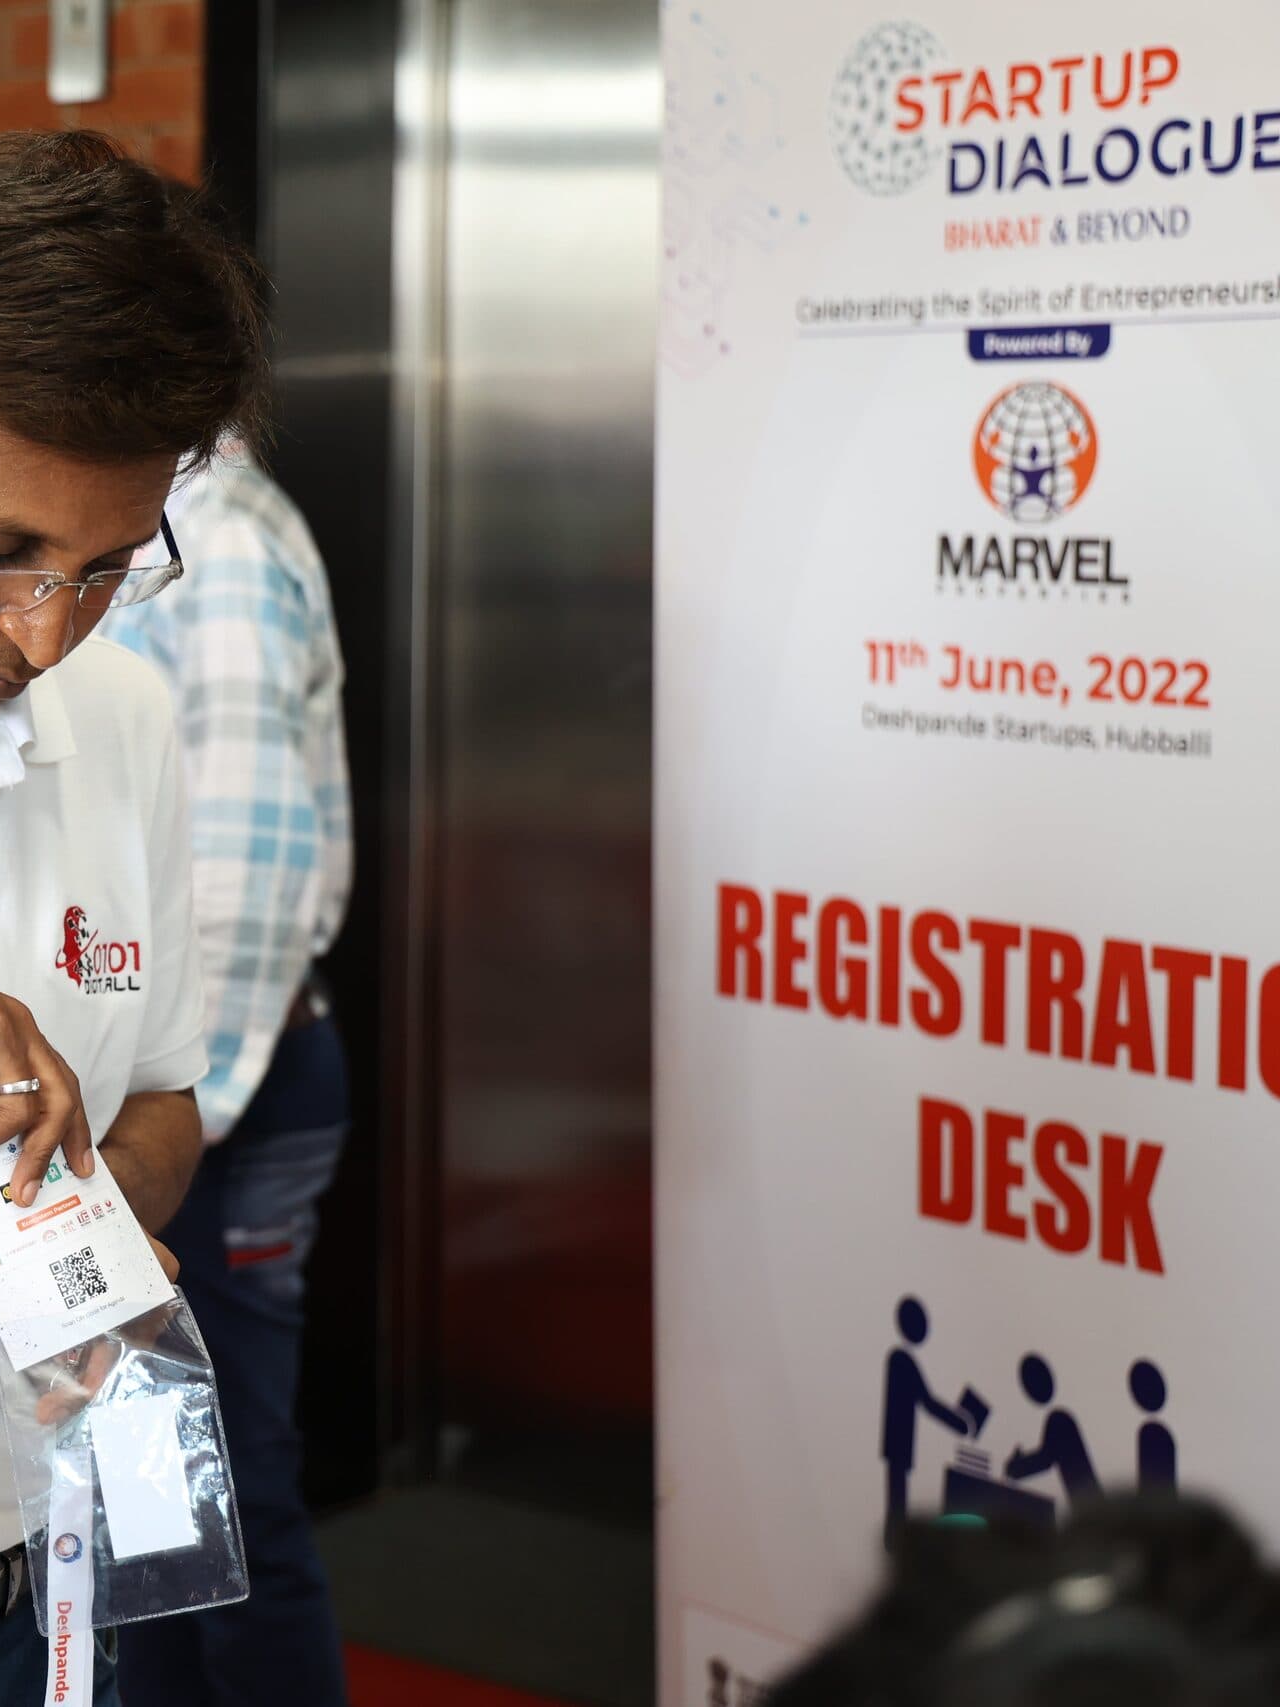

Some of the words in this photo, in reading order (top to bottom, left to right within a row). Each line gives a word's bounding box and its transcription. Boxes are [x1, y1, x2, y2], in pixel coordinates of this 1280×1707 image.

[895, 46, 1179, 132] STARTUP
[948, 111, 1280, 195] DIALOGUE
[944, 212, 1042, 251] BHARAT
[1050, 214, 1068, 246] &
[1077, 204, 1192, 244] BEYOND
[797, 294, 923, 326] Celebrating
[932, 289, 970, 315] the
[978, 284, 1041, 316] Spirit
[1048, 284, 1073, 312] of
[983, 330, 1063, 356] Powered
[1065, 329, 1092, 357] By
[939, 534, 1130, 584] MARVEL
[940, 644, 1071, 708] June,
[1086, 653, 1211, 709] 2022
[862, 702, 987, 739] Deshpande
[993, 715, 1098, 750] Startups,
[1105, 724, 1213, 758] Hubballi
[917, 1095, 1166, 1277] DESK
[54, 1601, 72, 1703] Deshpande
